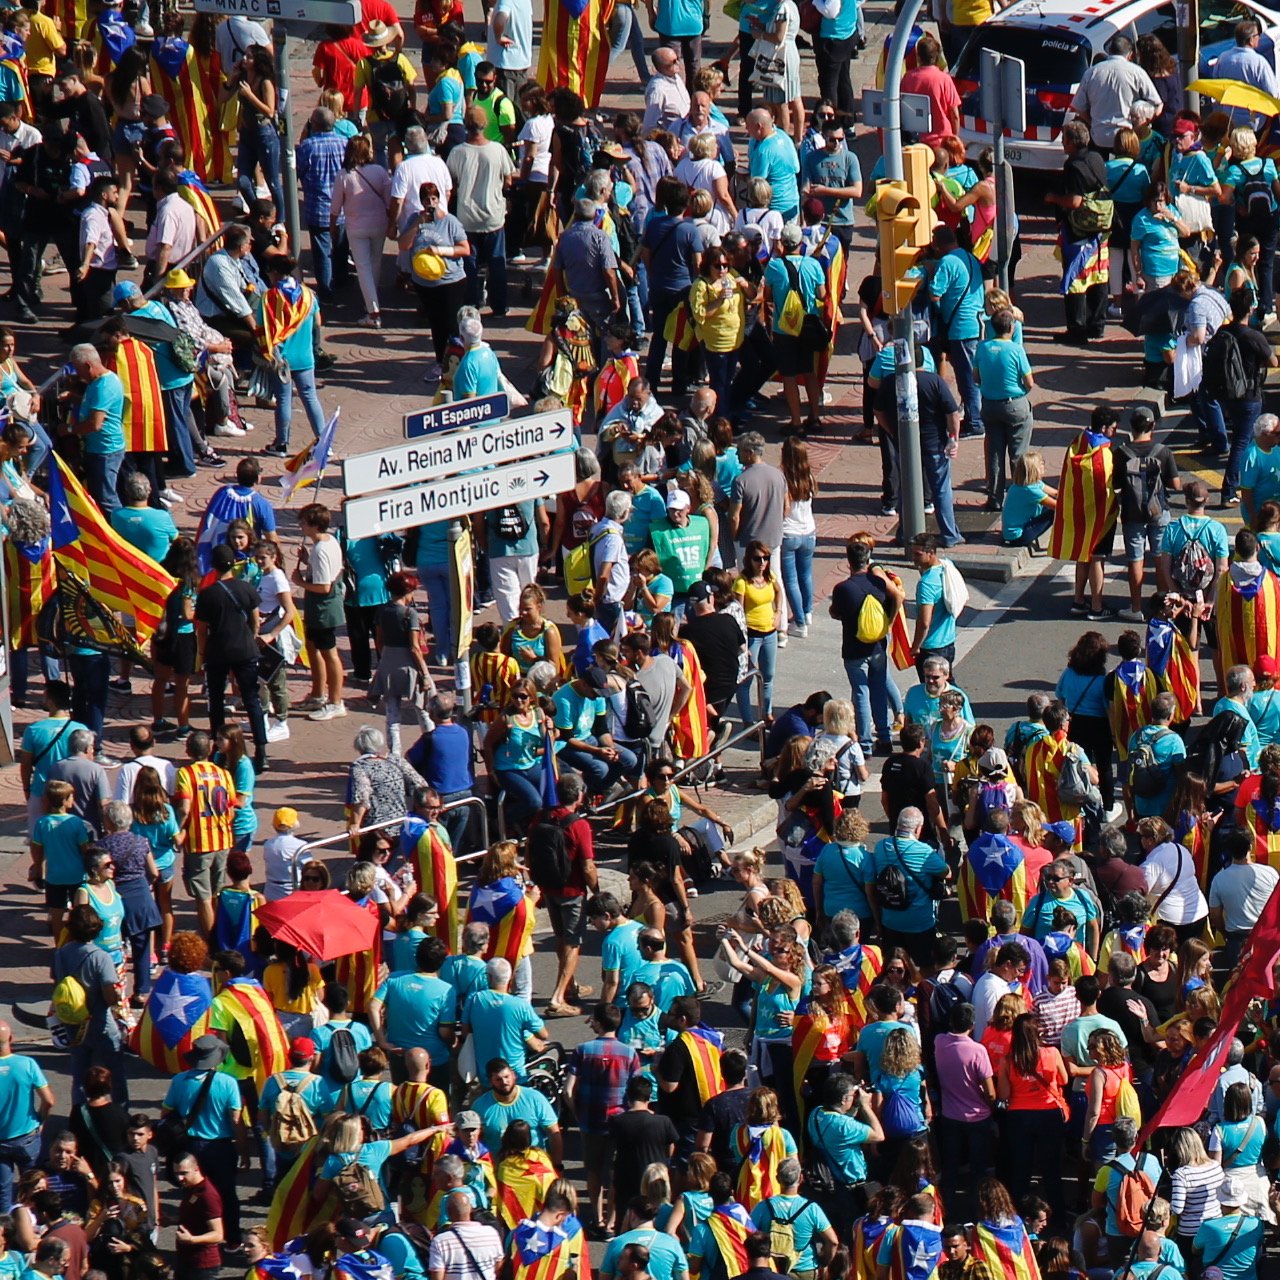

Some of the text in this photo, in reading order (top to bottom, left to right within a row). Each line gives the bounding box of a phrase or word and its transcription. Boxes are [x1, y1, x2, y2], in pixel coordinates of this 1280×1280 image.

[215, 0, 260, 12] MNAC
[422, 403, 492, 430] Pl. Espanya
[377, 426, 544, 479] Av. Reina Mª Cristina
[379, 479, 500, 522] Fira Montjuïc
[198, 784, 228, 817] 10
